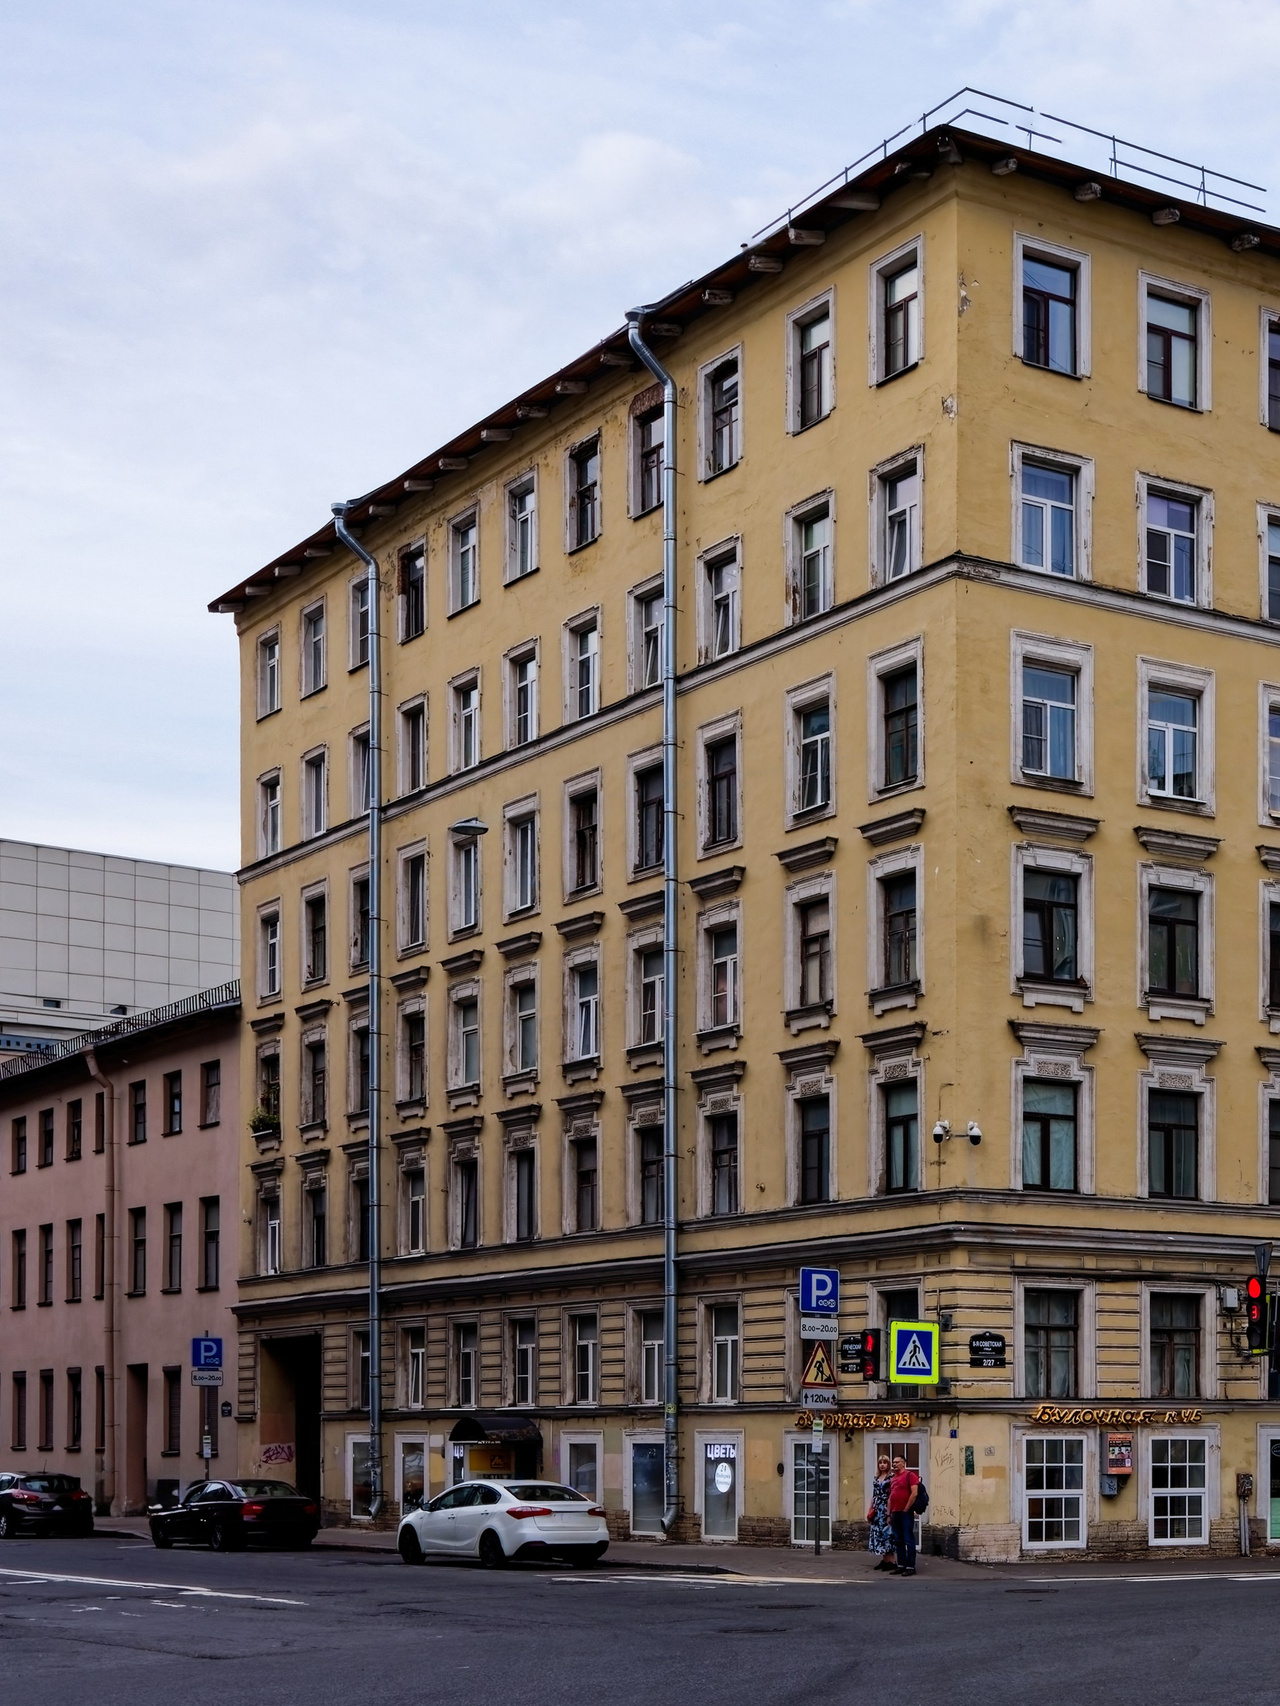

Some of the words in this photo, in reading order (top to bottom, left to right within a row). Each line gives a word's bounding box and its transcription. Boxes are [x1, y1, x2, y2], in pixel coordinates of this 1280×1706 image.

[811, 1273, 832, 1307] P
[200, 1341, 217, 1364] P
[982, 1358, 995, 1367] 2/27
